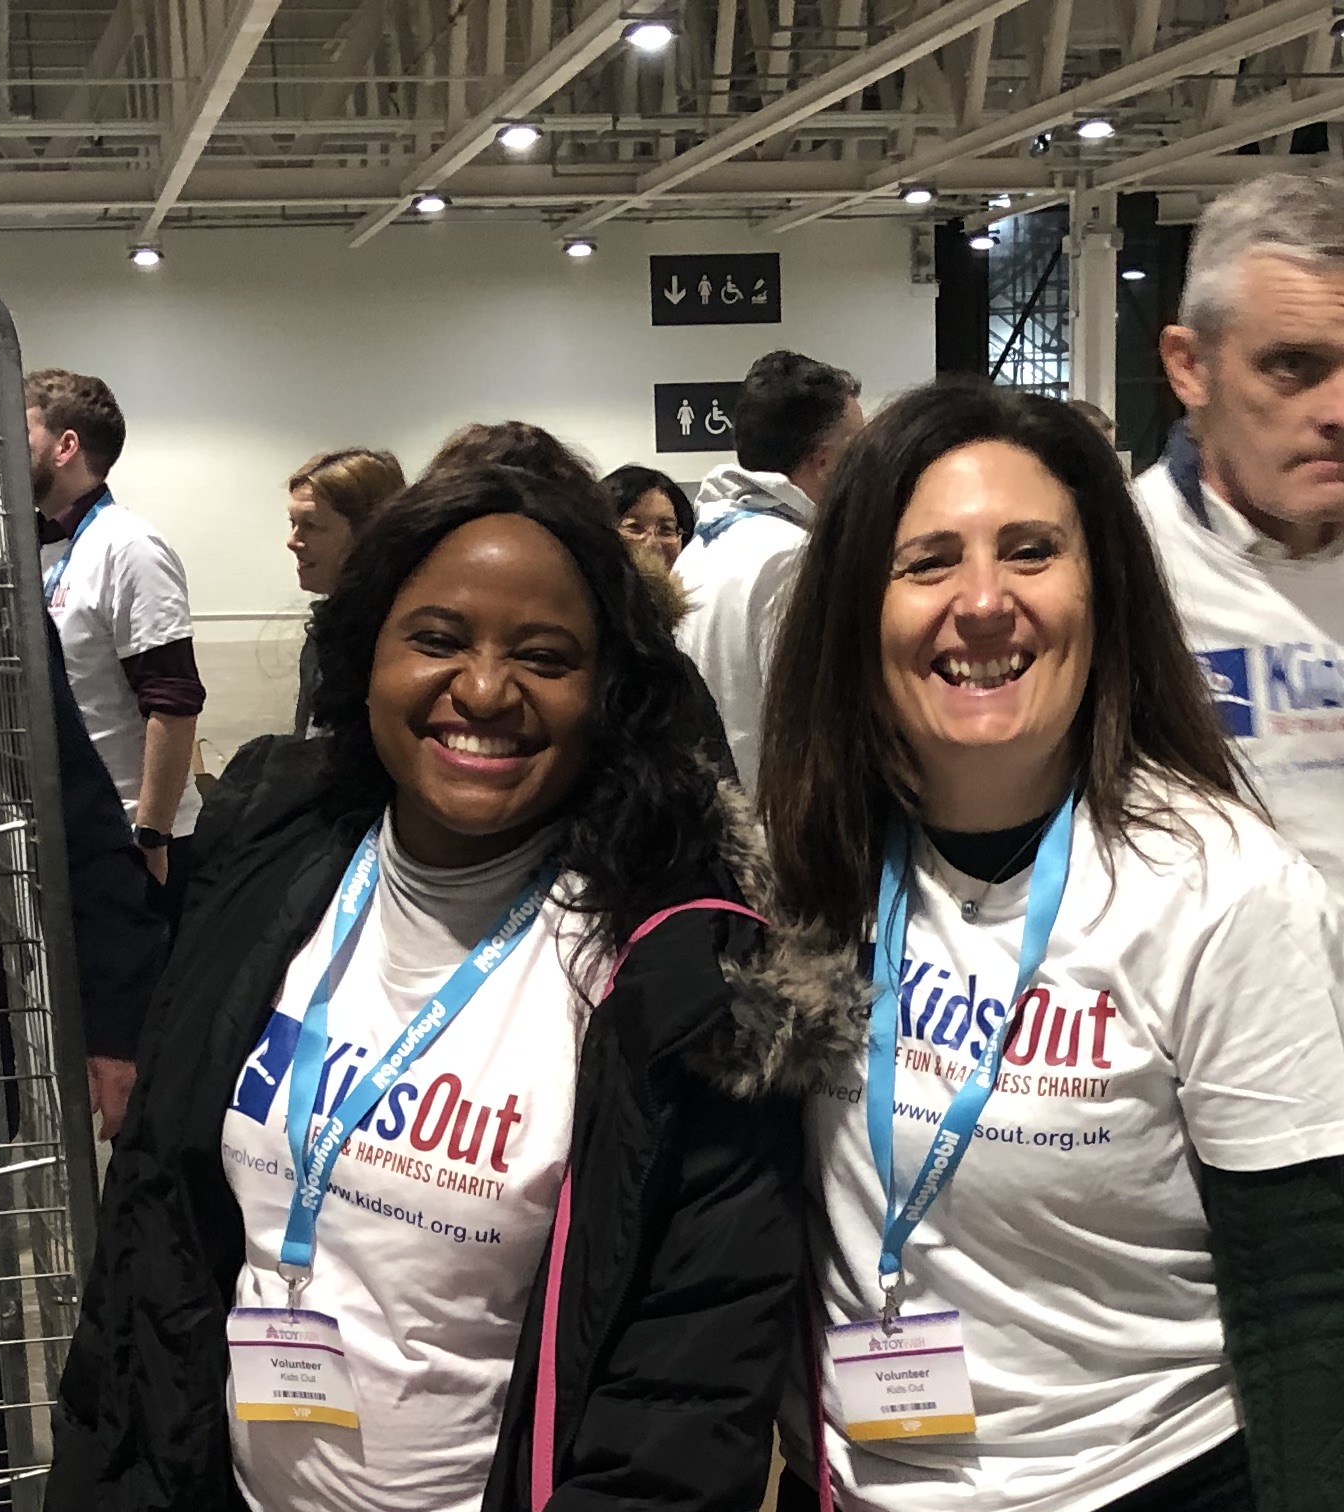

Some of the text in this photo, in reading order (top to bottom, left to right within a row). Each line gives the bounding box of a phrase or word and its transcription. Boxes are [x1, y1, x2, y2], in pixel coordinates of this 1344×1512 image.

[371, 1000, 446, 1090] playmobil
[906, 1048, 931, 1073] FUN
[934, 1054, 945, 1077] &
[1037, 1075, 1110, 1099] CHARITY
[284, 1167, 295, 1182] a
[300, 1116, 344, 1211] playmobil
[355, 1141, 432, 1186] HAPPINESS
[436, 1168, 505, 1202] CHARITY
[905, 1130, 961, 1222] playmobil
[270, 1357, 323, 1371] Volunteer
[280, 1372, 317, 1383] Kids Out
[875, 1368, 931, 1383] Volunteer
[886, 1384, 925, 1395] Kids Out
